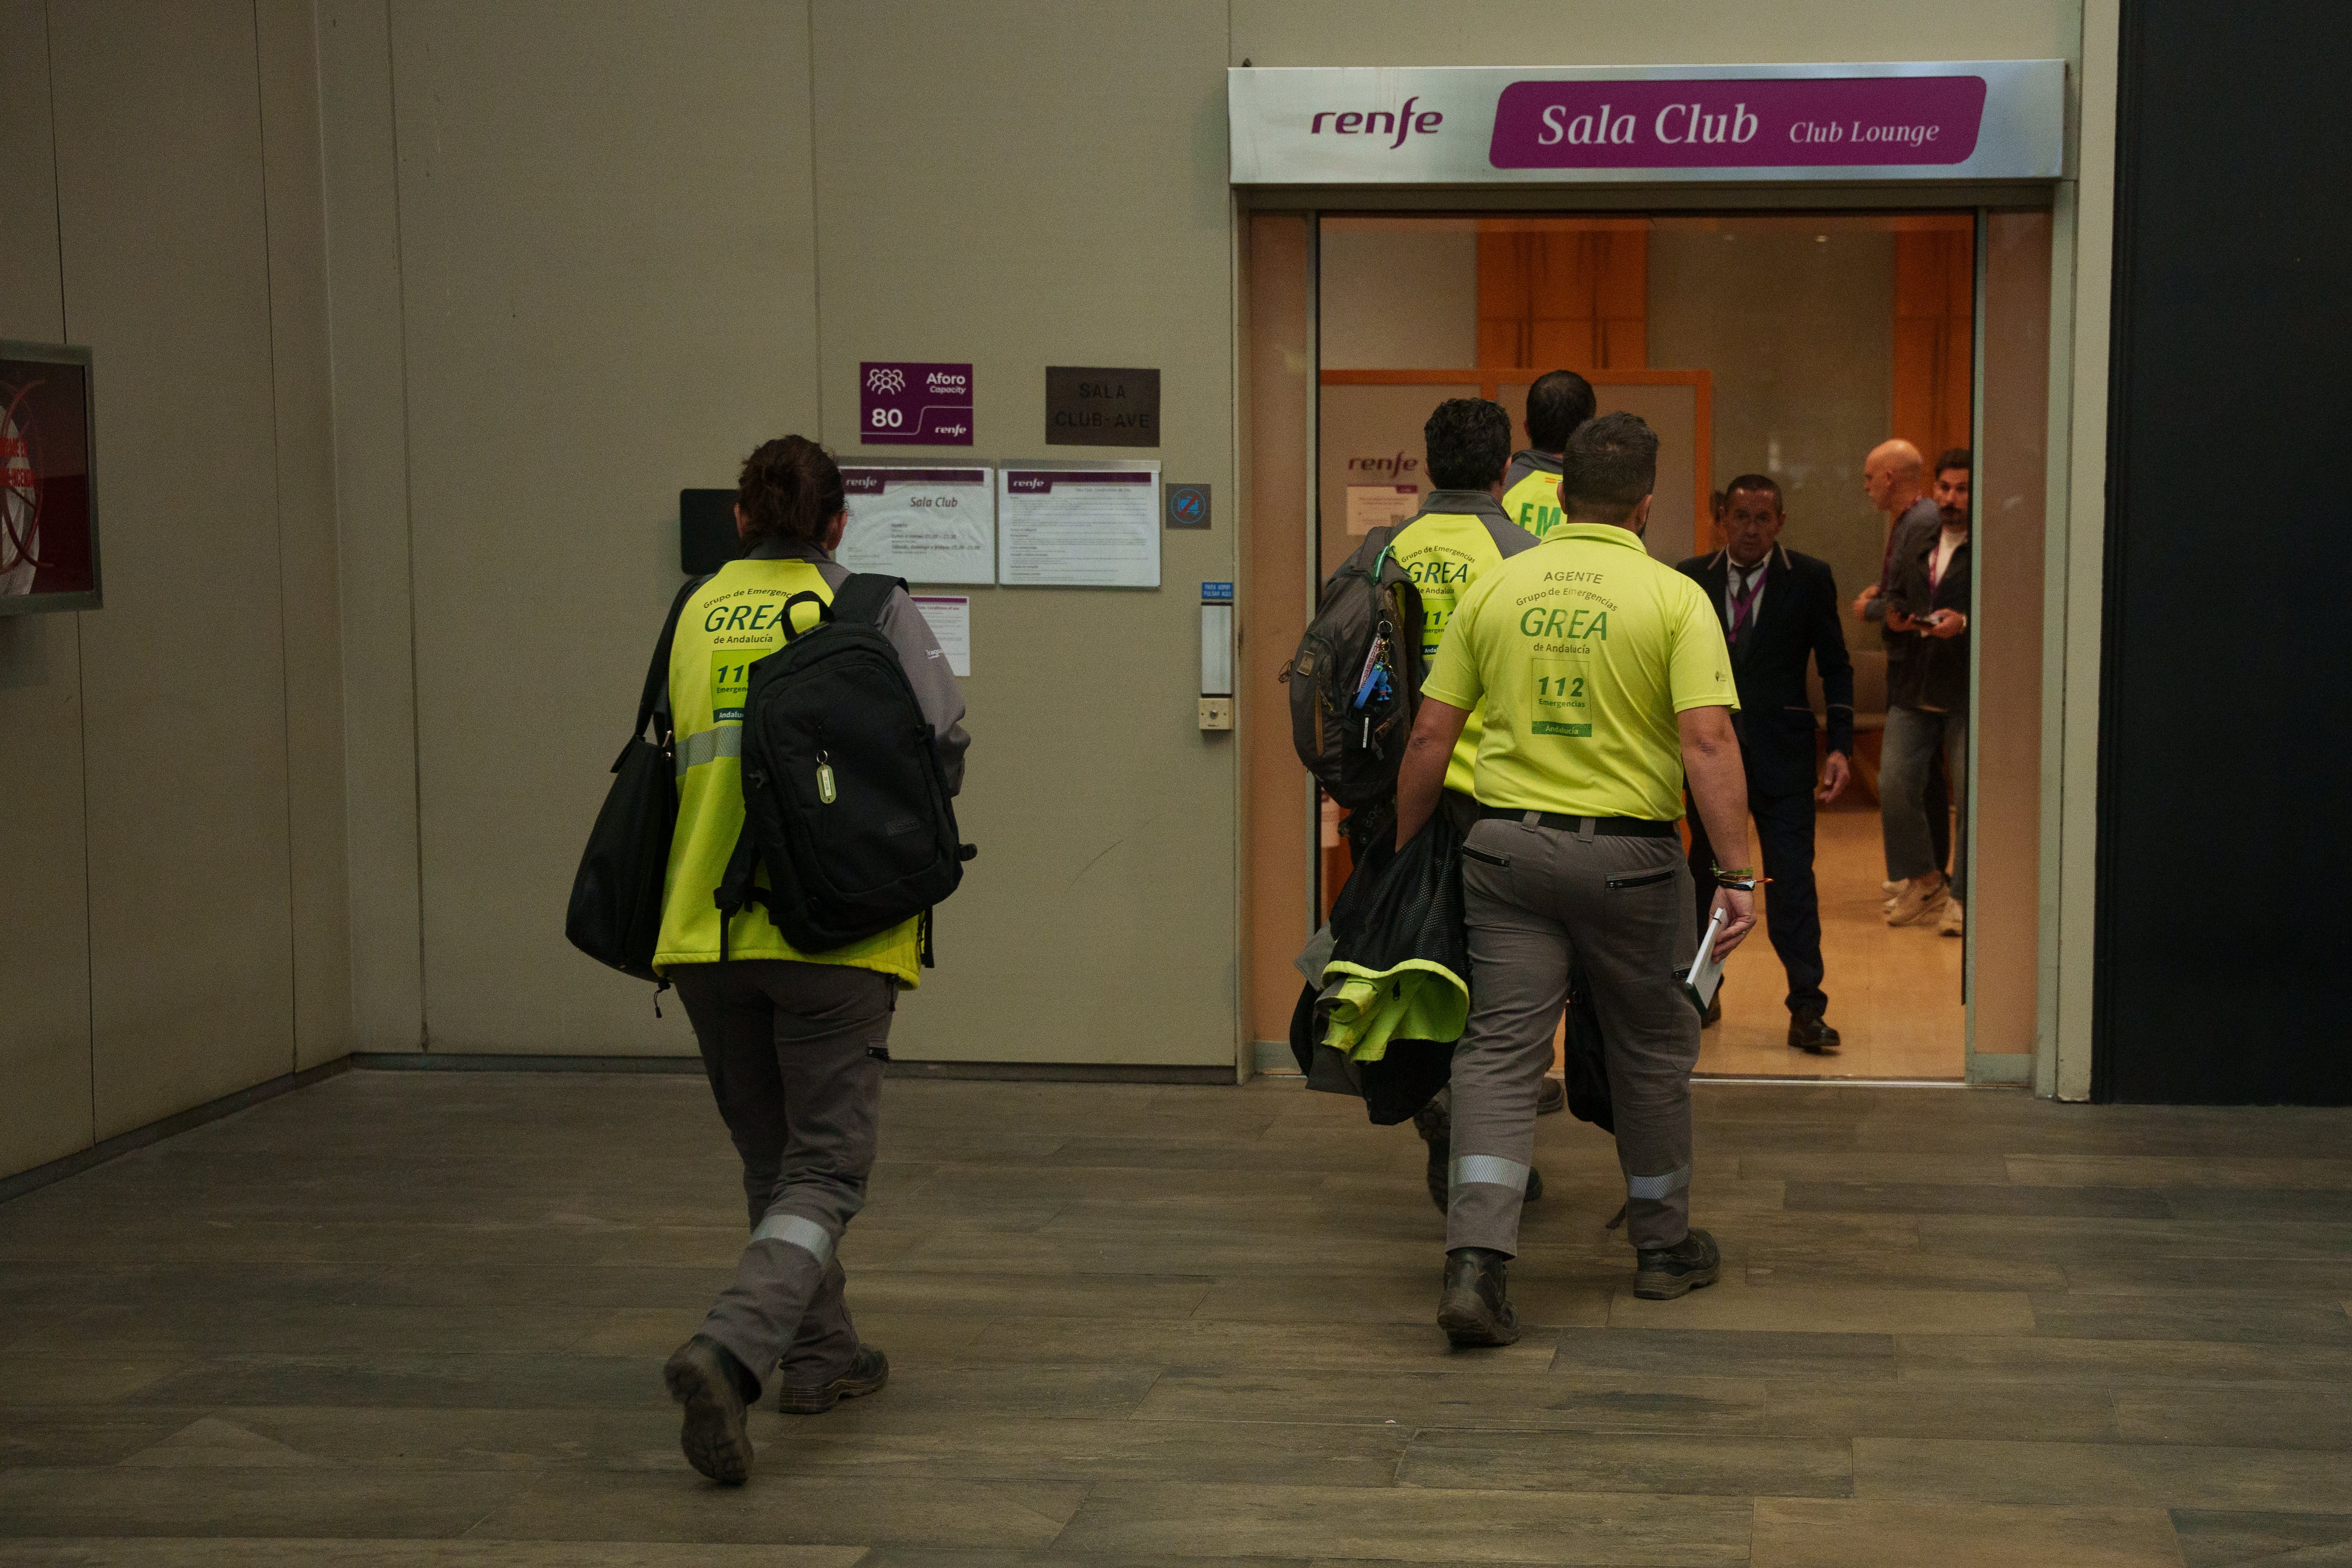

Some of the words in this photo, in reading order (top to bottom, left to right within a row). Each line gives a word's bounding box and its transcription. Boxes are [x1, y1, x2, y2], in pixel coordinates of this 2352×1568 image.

[1311, 95, 1444, 150] renfe
[1538, 103, 1637, 145] Sala
[1655, 102, 1759, 144] Club
[1789, 120, 1843, 143] Club
[1850, 120, 1940, 148] Lounge
[926, 372, 966, 385] Aforo
[929, 385, 967, 395] Capacity
[1079, 382, 1126, 399] SALA
[872, 408, 903, 428] 80
[934, 424, 967, 437] renfe
[1348, 451, 1418, 479] renfe
[846, 475, 878, 490] renfe
[1012, 477, 1045, 490] renfe
[910, 496, 932, 508] Sala
[935, 496, 958, 508] Club
[1519, 502, 1562, 537] EM
[1401, 550, 1422, 563] Grupo
[1406, 561, 1468, 584] GREA
[1543, 571, 1604, 584] AGENTE
[703, 594, 731, 609] Grupo
[747, 588, 795, 599] Emergenc
[1516, 591, 1547, 606] Grupo
[1563, 588, 1618, 612] Emergencias
[1520, 607, 1607, 641] GREA
[714, 636, 725, 644] de
[726, 634, 773, 643] Andalucía
[1534, 643, 1544, 651] de
[1546, 644, 1590, 654] Andalucía
[717, 665, 748, 683] 11
[1538, 676, 1585, 697] 112
[1538, 698, 1586, 708] Emergencias
[718, 711, 744, 719] Andalu
[1545, 725, 1579, 735] Andalucía
